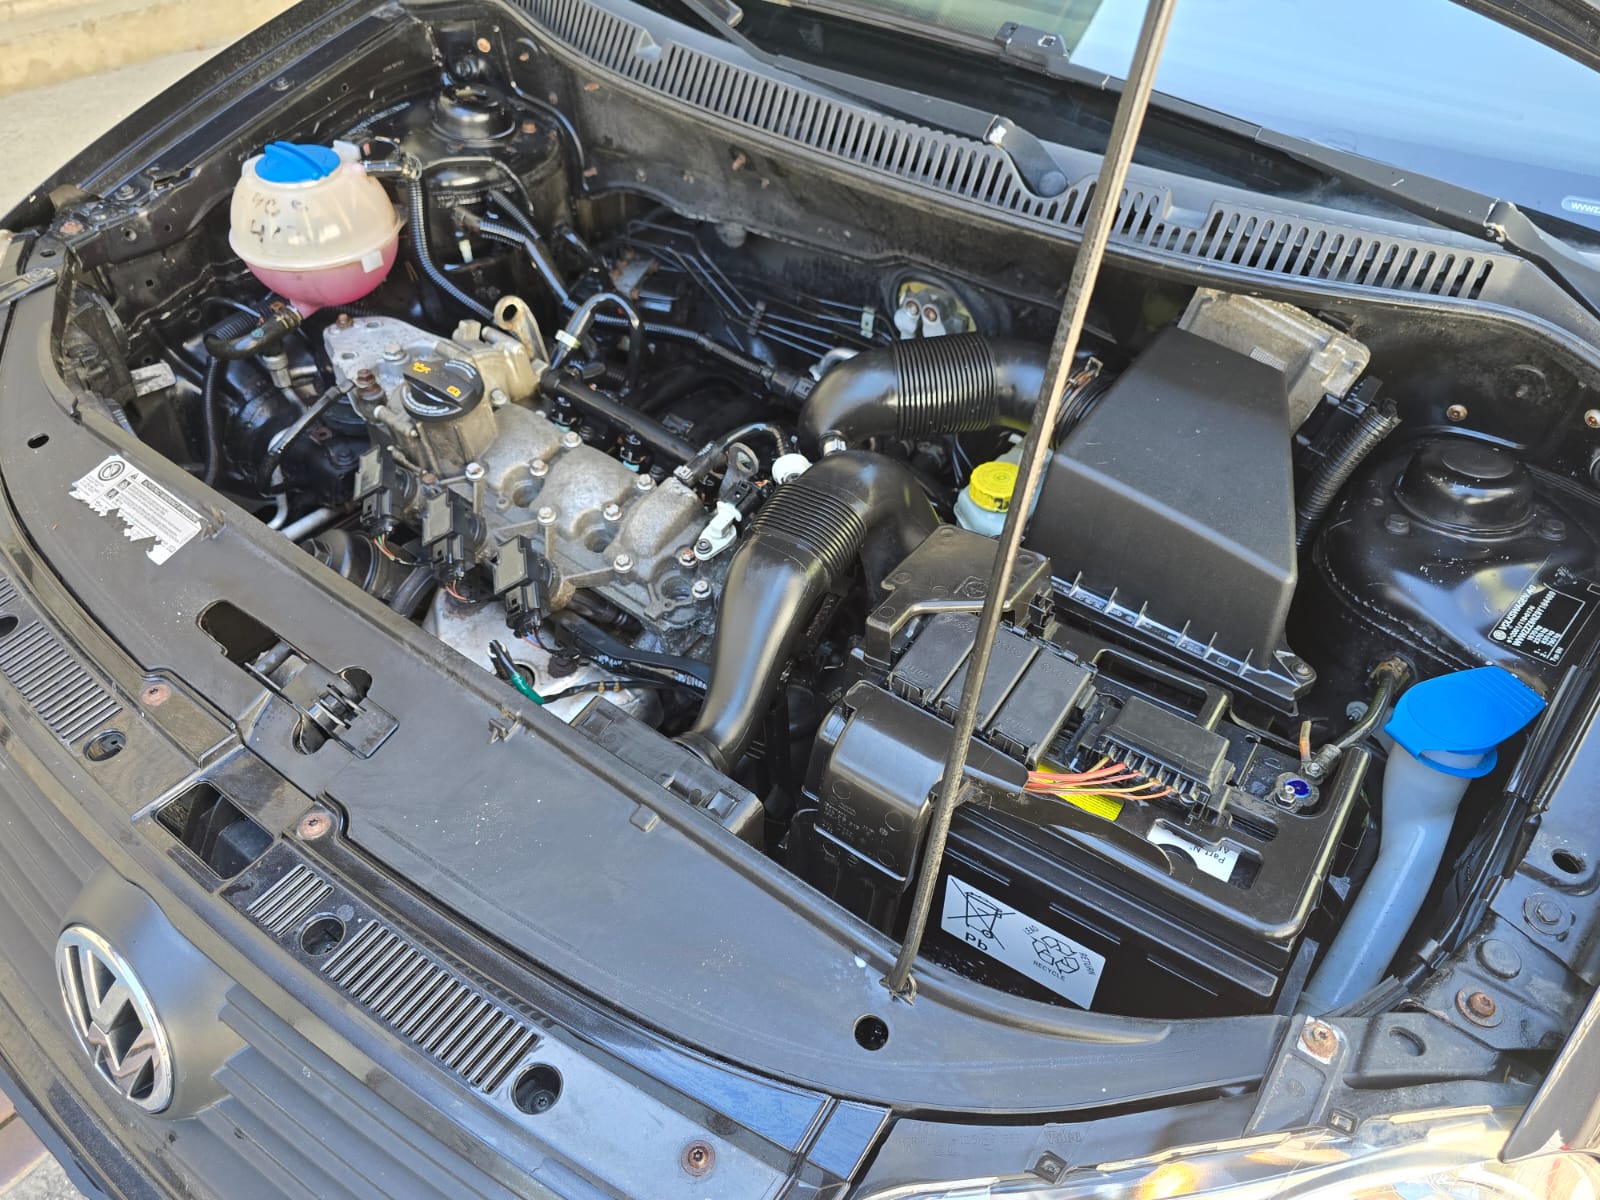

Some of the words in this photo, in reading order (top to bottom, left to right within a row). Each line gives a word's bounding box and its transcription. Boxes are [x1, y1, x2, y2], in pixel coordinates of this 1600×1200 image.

[1499, 593, 1530, 631] VOLKSWAGEN
[1526, 584, 1537, 596] AG
[1204, 850, 1226, 864] Part
[964, 932, 989, 951] Pb
[1033, 960, 1066, 982] RECYCLE
[1080, 952, 1096, 975] RETURN
